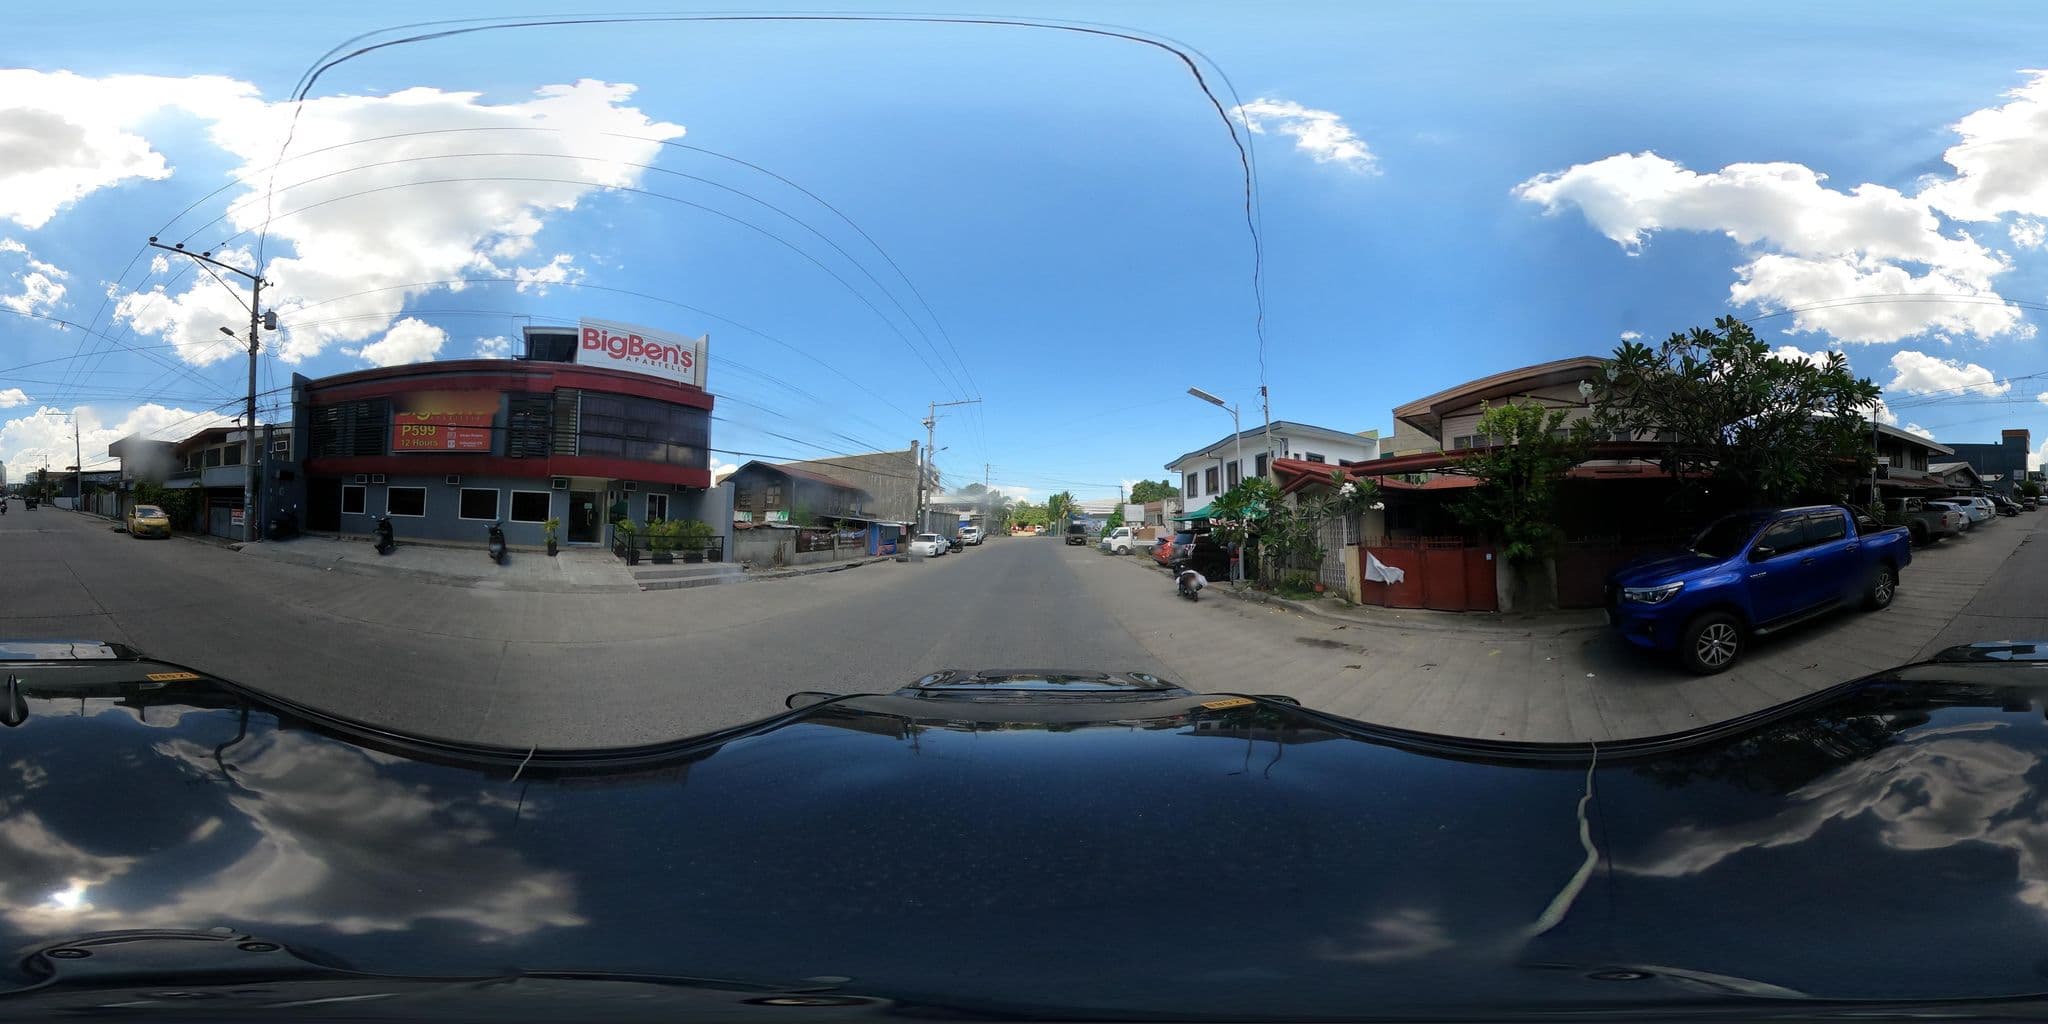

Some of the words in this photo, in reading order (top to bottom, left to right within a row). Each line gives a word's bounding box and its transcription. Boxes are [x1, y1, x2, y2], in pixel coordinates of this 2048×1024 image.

[582, 327, 693, 368] BigBen's
[625, 356, 688, 374] APARTELLE
[401, 438, 411, 447] 12
[413, 438, 438, 447] Hours
